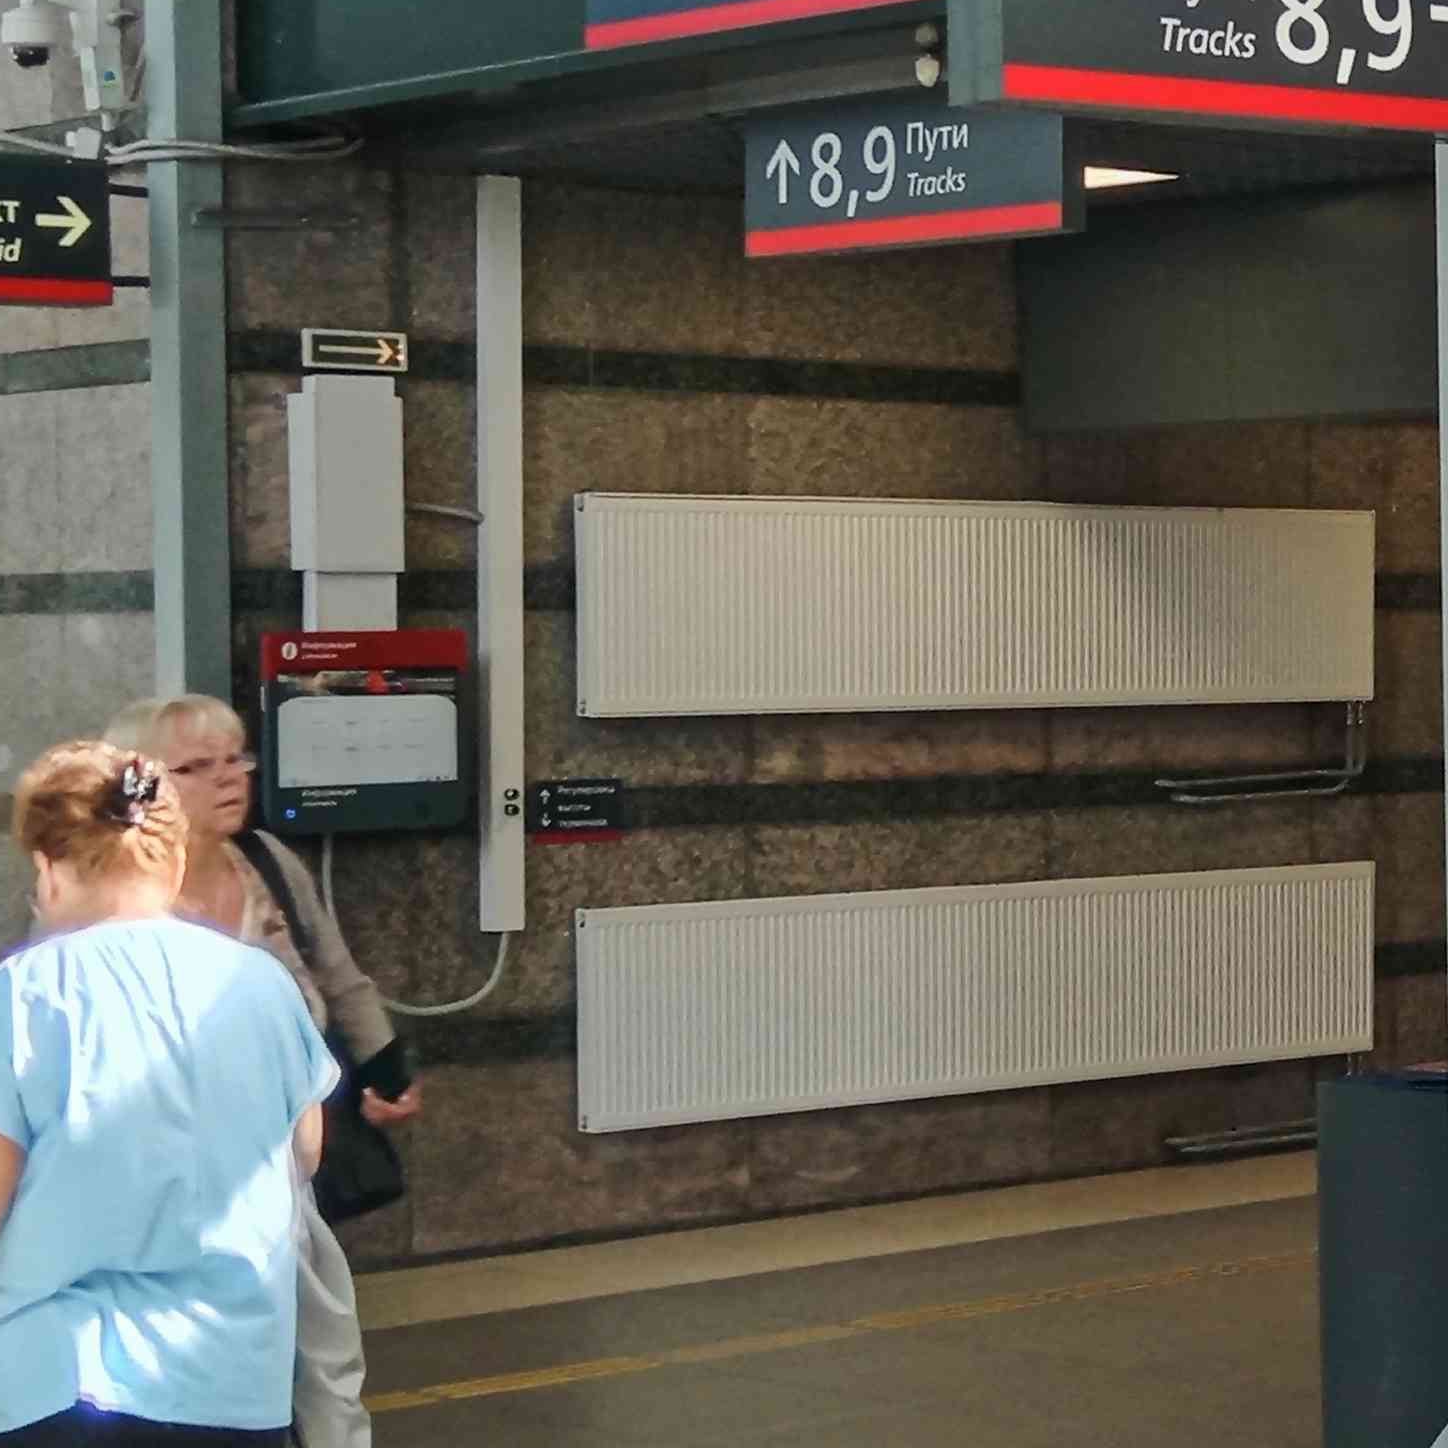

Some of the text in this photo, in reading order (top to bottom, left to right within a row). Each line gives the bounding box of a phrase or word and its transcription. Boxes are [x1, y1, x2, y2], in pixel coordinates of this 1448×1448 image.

[1160, 18, 1256, 59] Tracks
[810, 120, 968, 216] 8,9 Пути
[907, 167, 966, 198] Tracks
